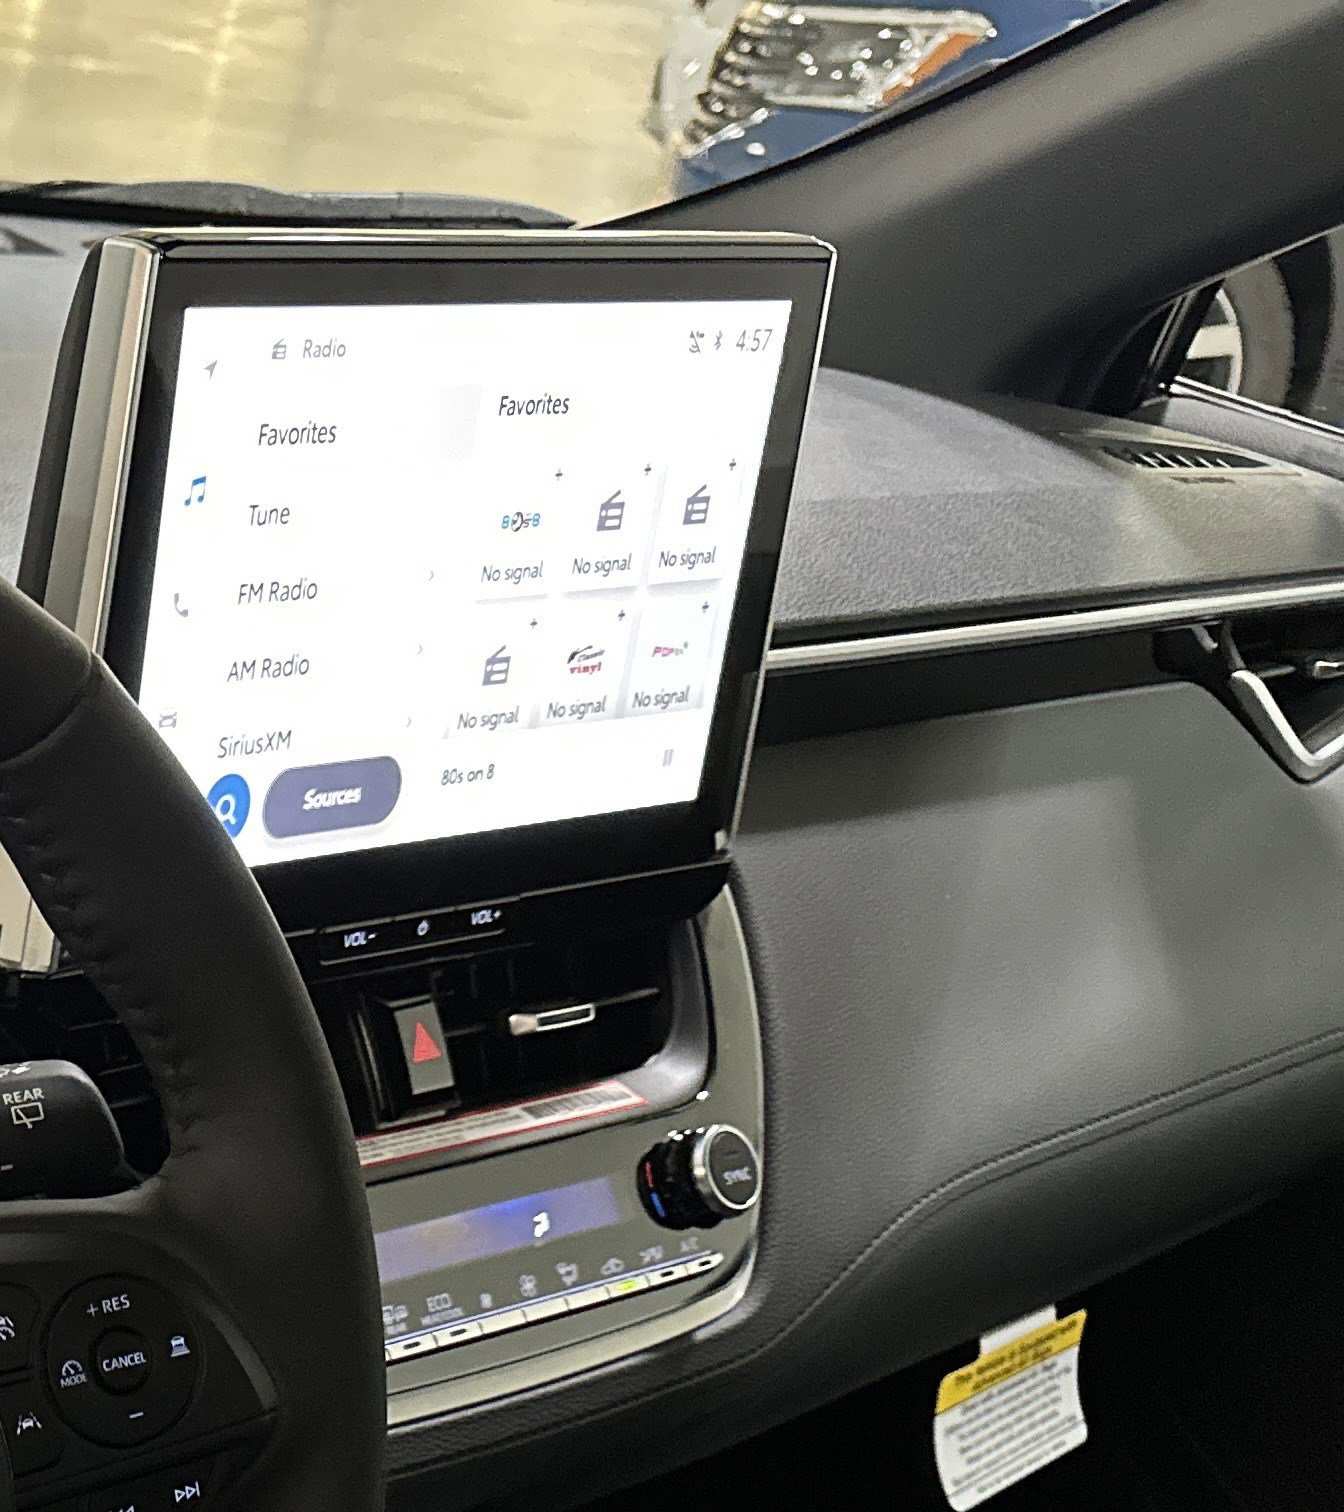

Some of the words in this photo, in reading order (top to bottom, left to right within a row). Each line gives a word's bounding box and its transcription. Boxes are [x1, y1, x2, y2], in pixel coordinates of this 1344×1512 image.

[302, 338, 347, 359] Radio
[735, 328, 773, 352] 4:57
[498, 393, 570, 417] Favorites
[257, 420, 337, 447] Favorites
[248, 504, 291, 527] Tune
[572, 557, 591, 575] No
[593, 552, 633, 576] signal
[658, 550, 678, 568] No
[679, 546, 717, 571] signal
[481, 566, 502, 583] No
[505, 560, 544, 585] signal
[237, 582, 265, 605] FM
[268, 577, 319, 603] Radio
[227, 657, 257, 682] AM
[259, 653, 311, 680] Radio
[546, 702, 567, 719] No
[568, 695, 607, 720] signal
[632, 691, 651, 708] No
[653, 685, 690, 710] signal
[457, 713, 477, 730] No
[479, 705, 519, 732] signal
[217, 729, 293, 760] SiriusXM
[440, 767, 464, 786] 80s
[467, 767, 485, 783] on
[486, 763, 496, 780] 8
[302, 785, 363, 811] Sources
[2, 1086, 45, 1106] REAR
[101, 1293, 131, 1314] RES
[102, 1351, 147, 1373] CANCEL
[60, 1373, 88, 1388] MODE
